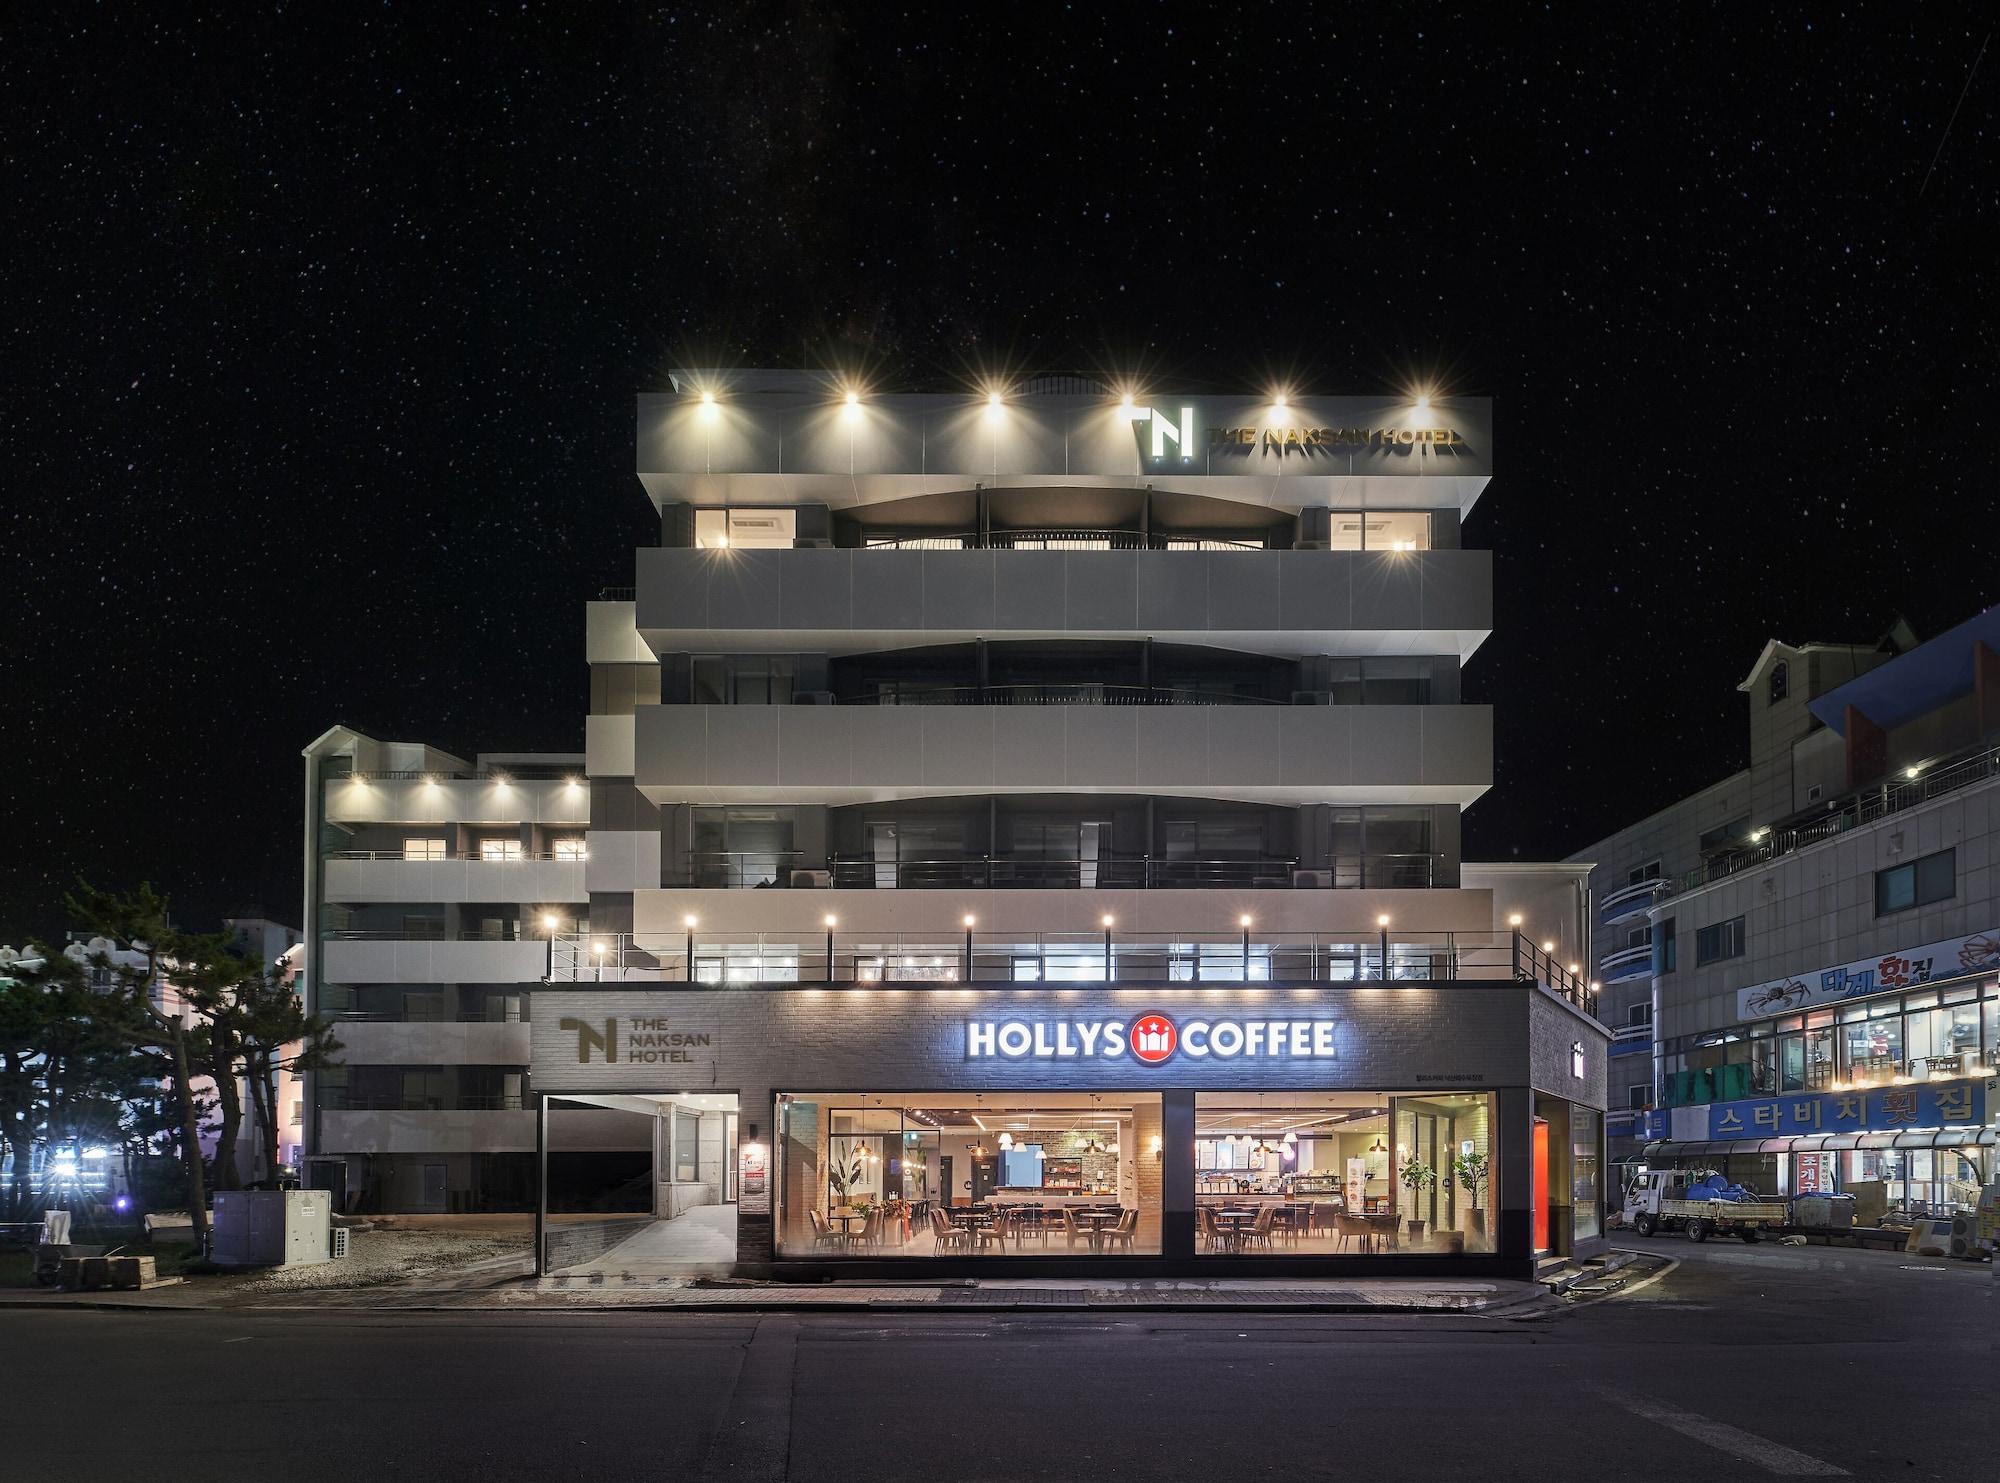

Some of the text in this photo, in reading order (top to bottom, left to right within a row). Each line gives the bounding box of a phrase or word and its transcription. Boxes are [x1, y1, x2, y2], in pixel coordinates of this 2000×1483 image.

[1209, 428, 1256, 445] THE
[1264, 428, 1371, 446] NAKSAN
[1380, 428, 1464, 446] HOTEL
[629, 1018, 669, 1031] THE
[629, 1033, 710, 1047] NAKSAN
[969, 1022, 1335, 1056] HOLLYS COFFEE
[629, 1050, 694, 1063] HOTEL
